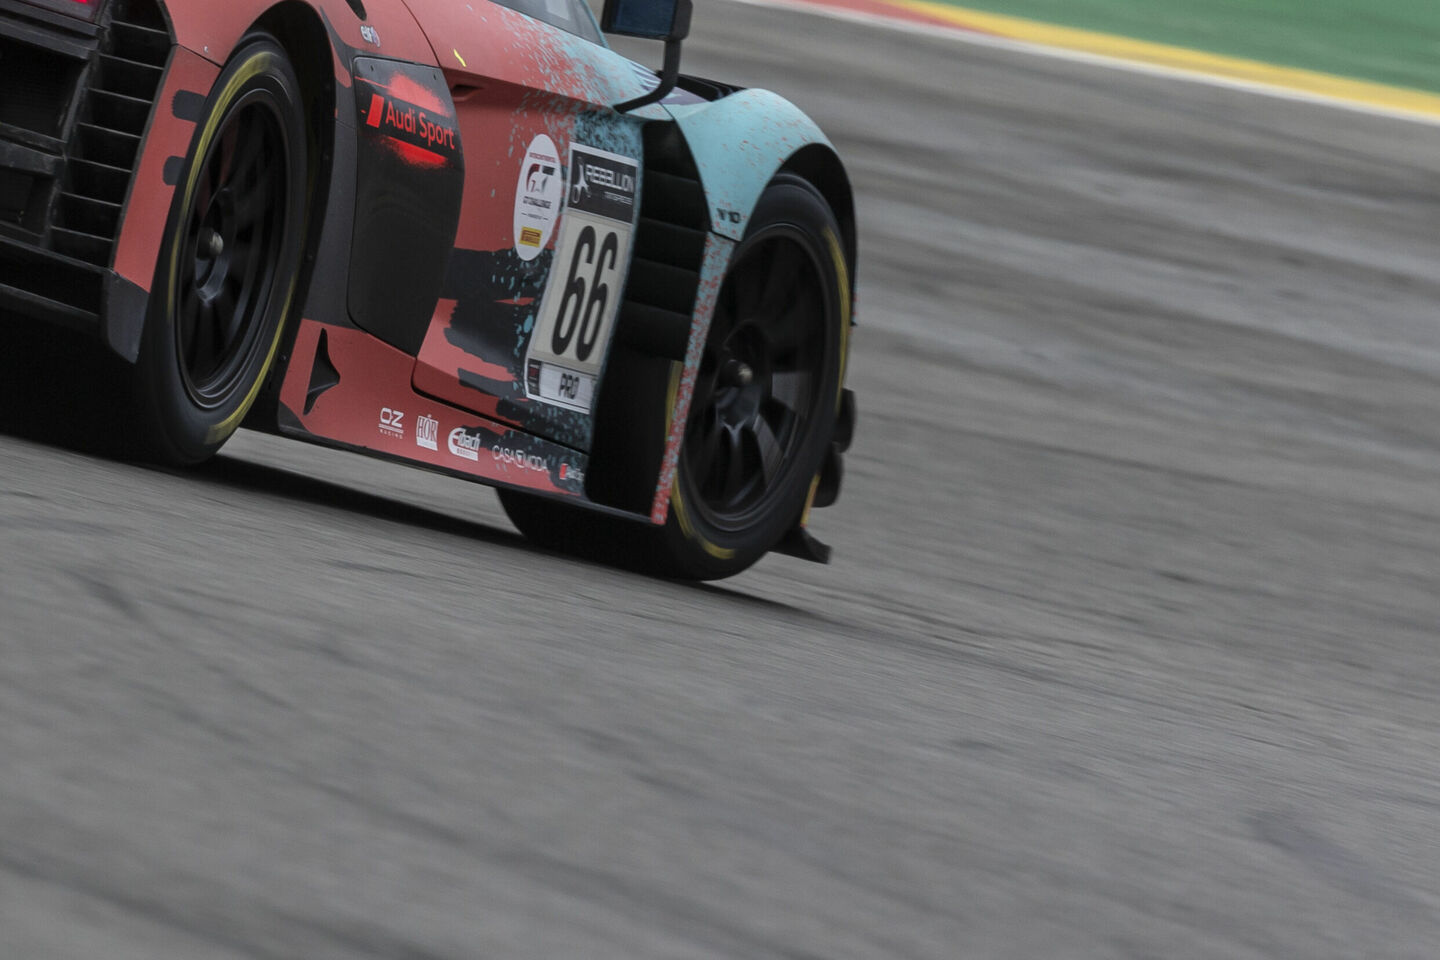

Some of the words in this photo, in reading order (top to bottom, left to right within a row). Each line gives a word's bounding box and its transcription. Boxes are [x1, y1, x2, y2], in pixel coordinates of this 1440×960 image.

[385, 100, 416, 135] Audi
[419, 113, 455, 150] Sport
[585, 163, 634, 193] REBELLION
[551, 225, 619, 362] 66
[559, 372, 580, 400] PRO
[380, 407, 404, 428] OZ
[492, 444, 515, 464] CASA
